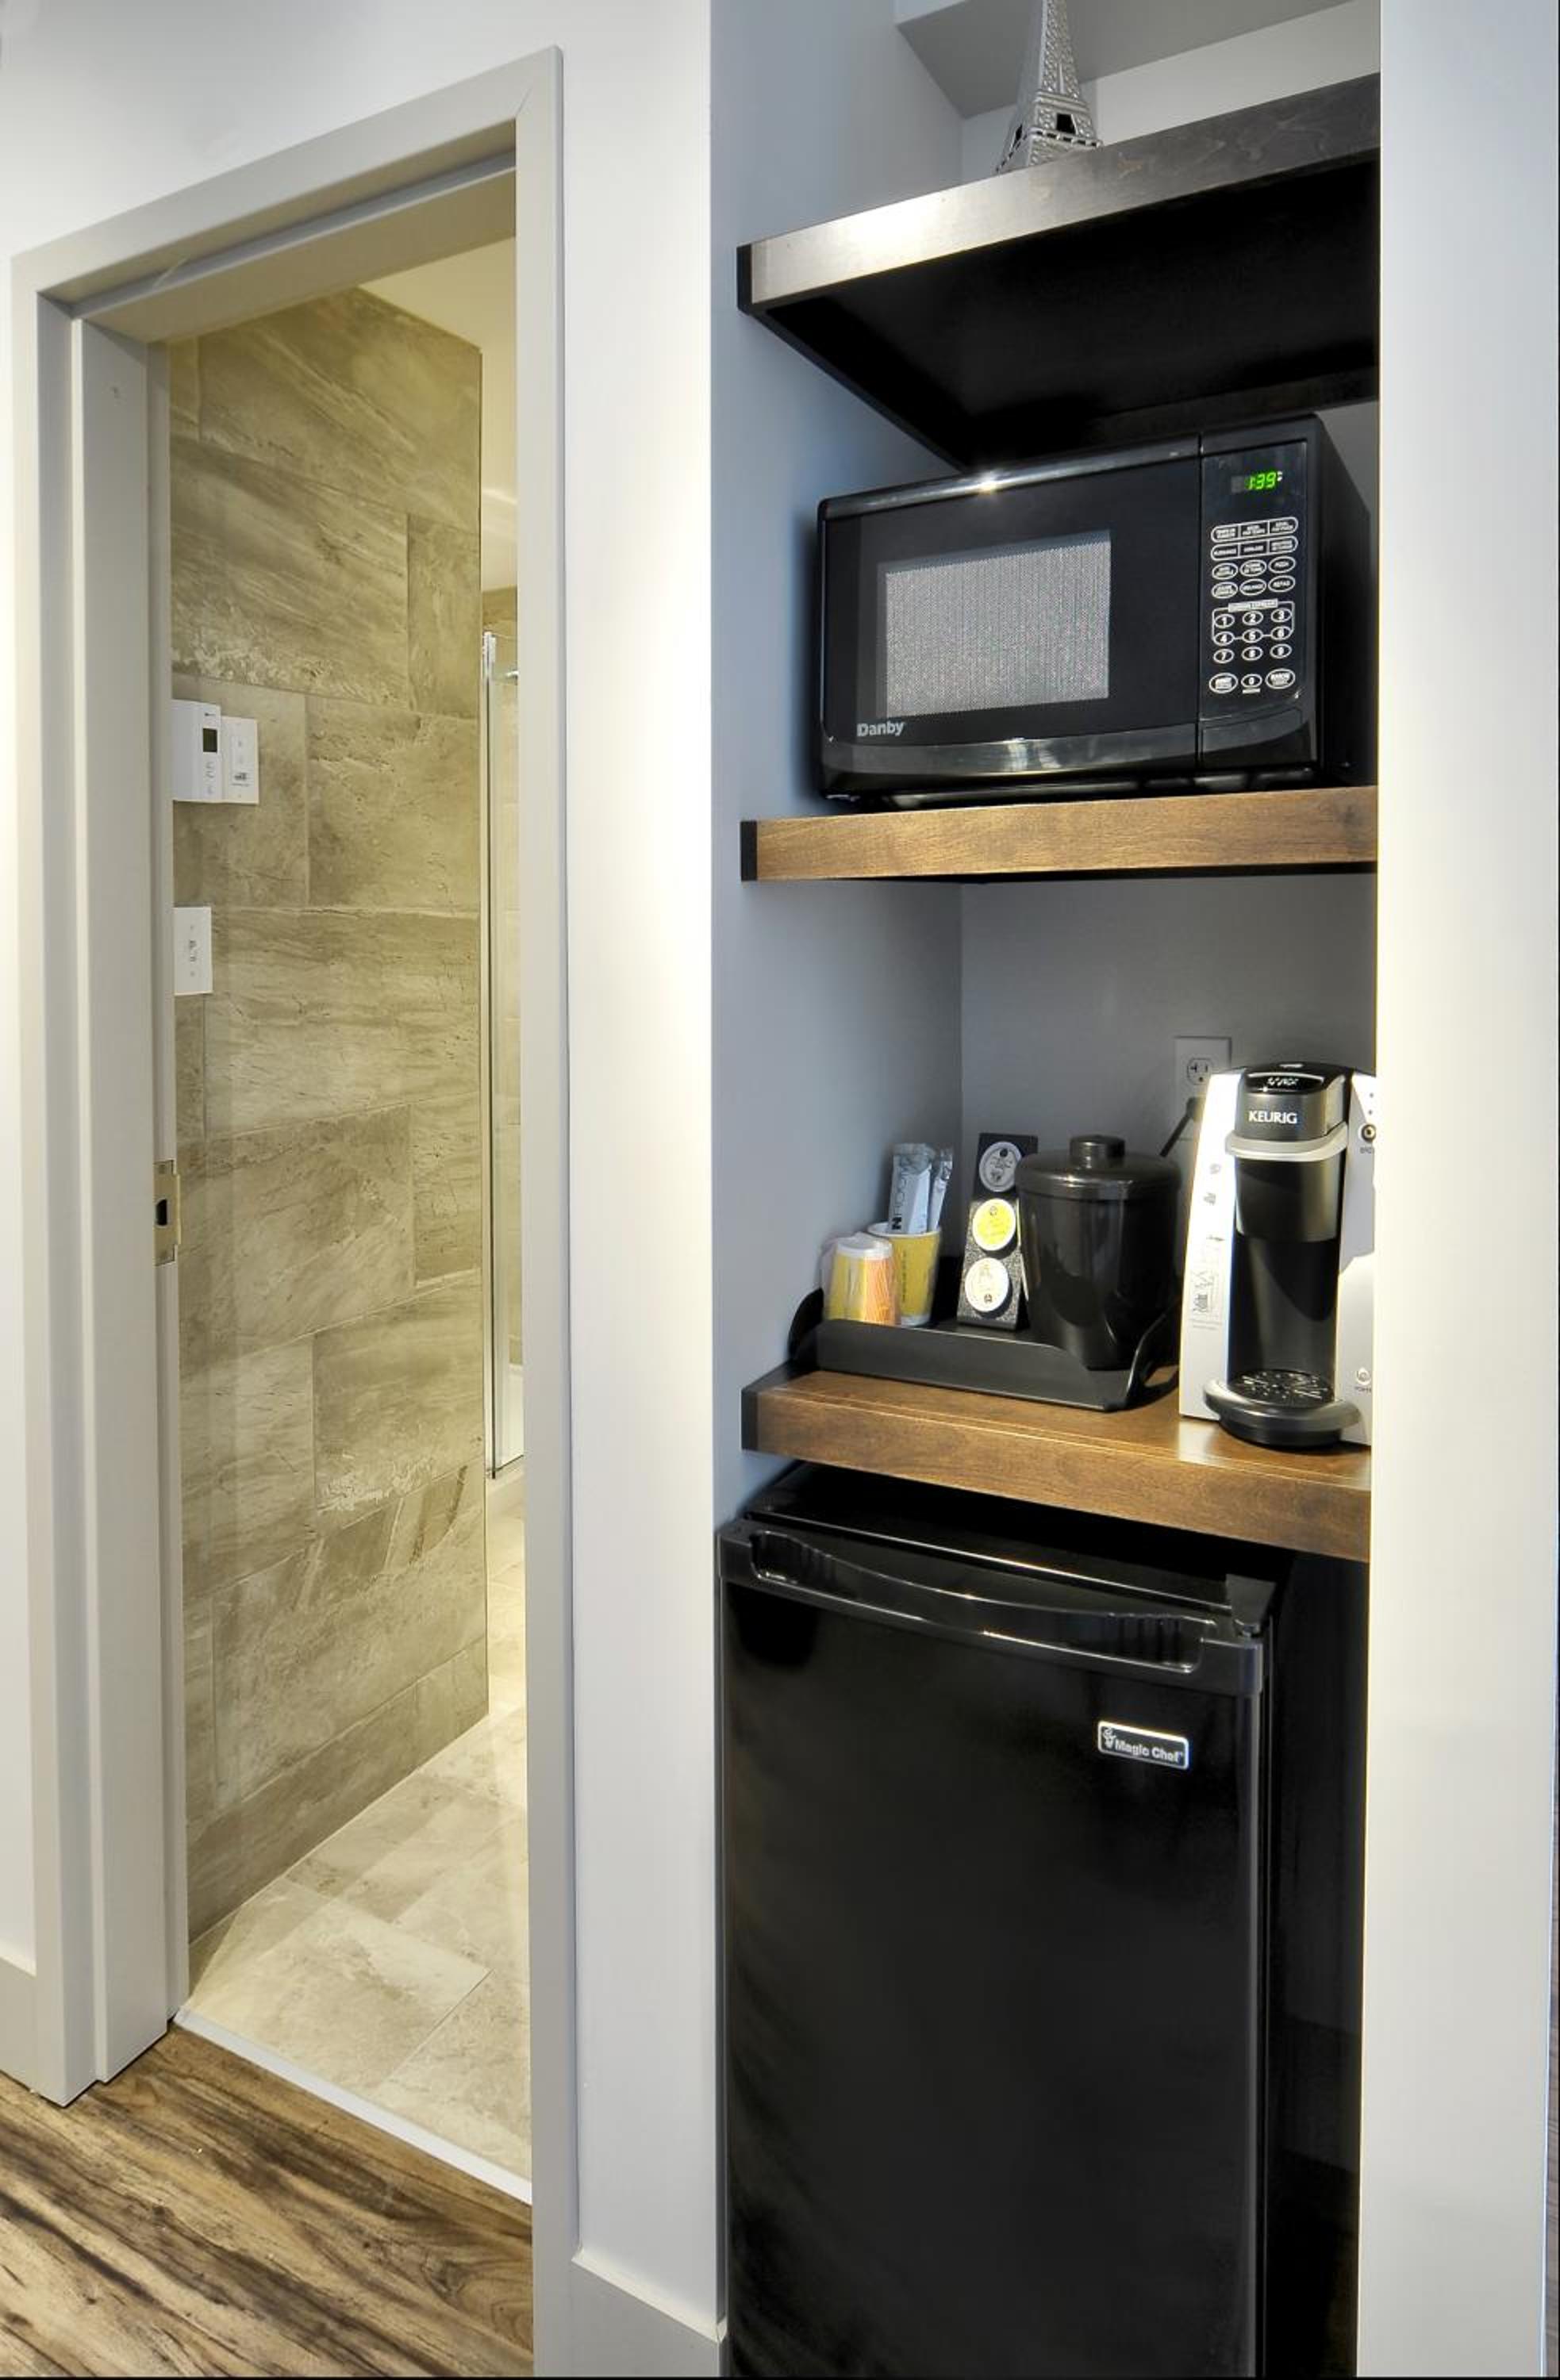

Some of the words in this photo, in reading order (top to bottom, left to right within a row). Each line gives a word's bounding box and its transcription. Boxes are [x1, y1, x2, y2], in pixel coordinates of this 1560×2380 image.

[857, 721, 905, 736] Danby
[1248, 1110, 1297, 1124] KEURIG
[1115, 1739, 1149, 1756] Magic
[1151, 1747, 1181, 1763] Chef
